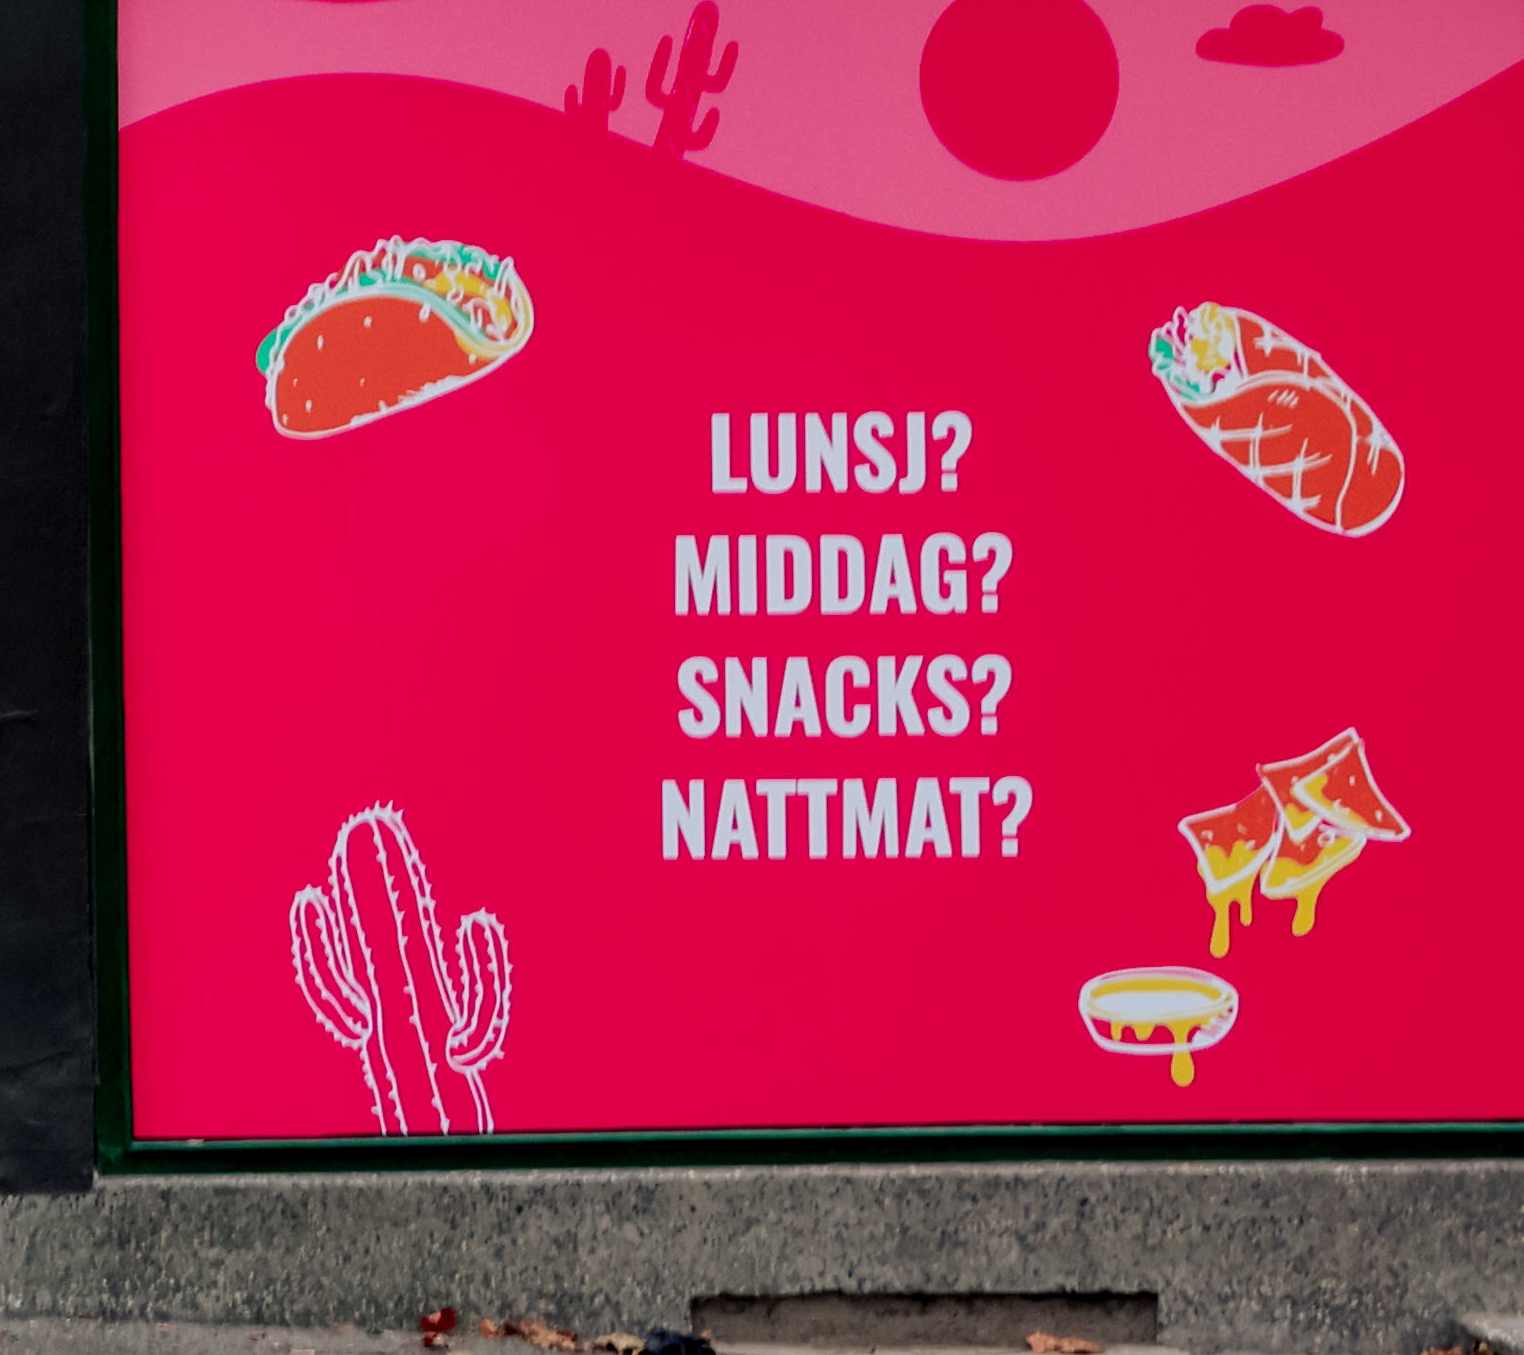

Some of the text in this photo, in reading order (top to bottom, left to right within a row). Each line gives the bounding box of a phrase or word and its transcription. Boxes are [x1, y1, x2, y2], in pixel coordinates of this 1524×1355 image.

[711, 411, 972, 494] LUNSJ?
[675, 532, 1013, 615] MIDDAG?
[677, 654, 1012, 738] SNACKS?
[662, 776, 1033, 859] NATTMAT?
